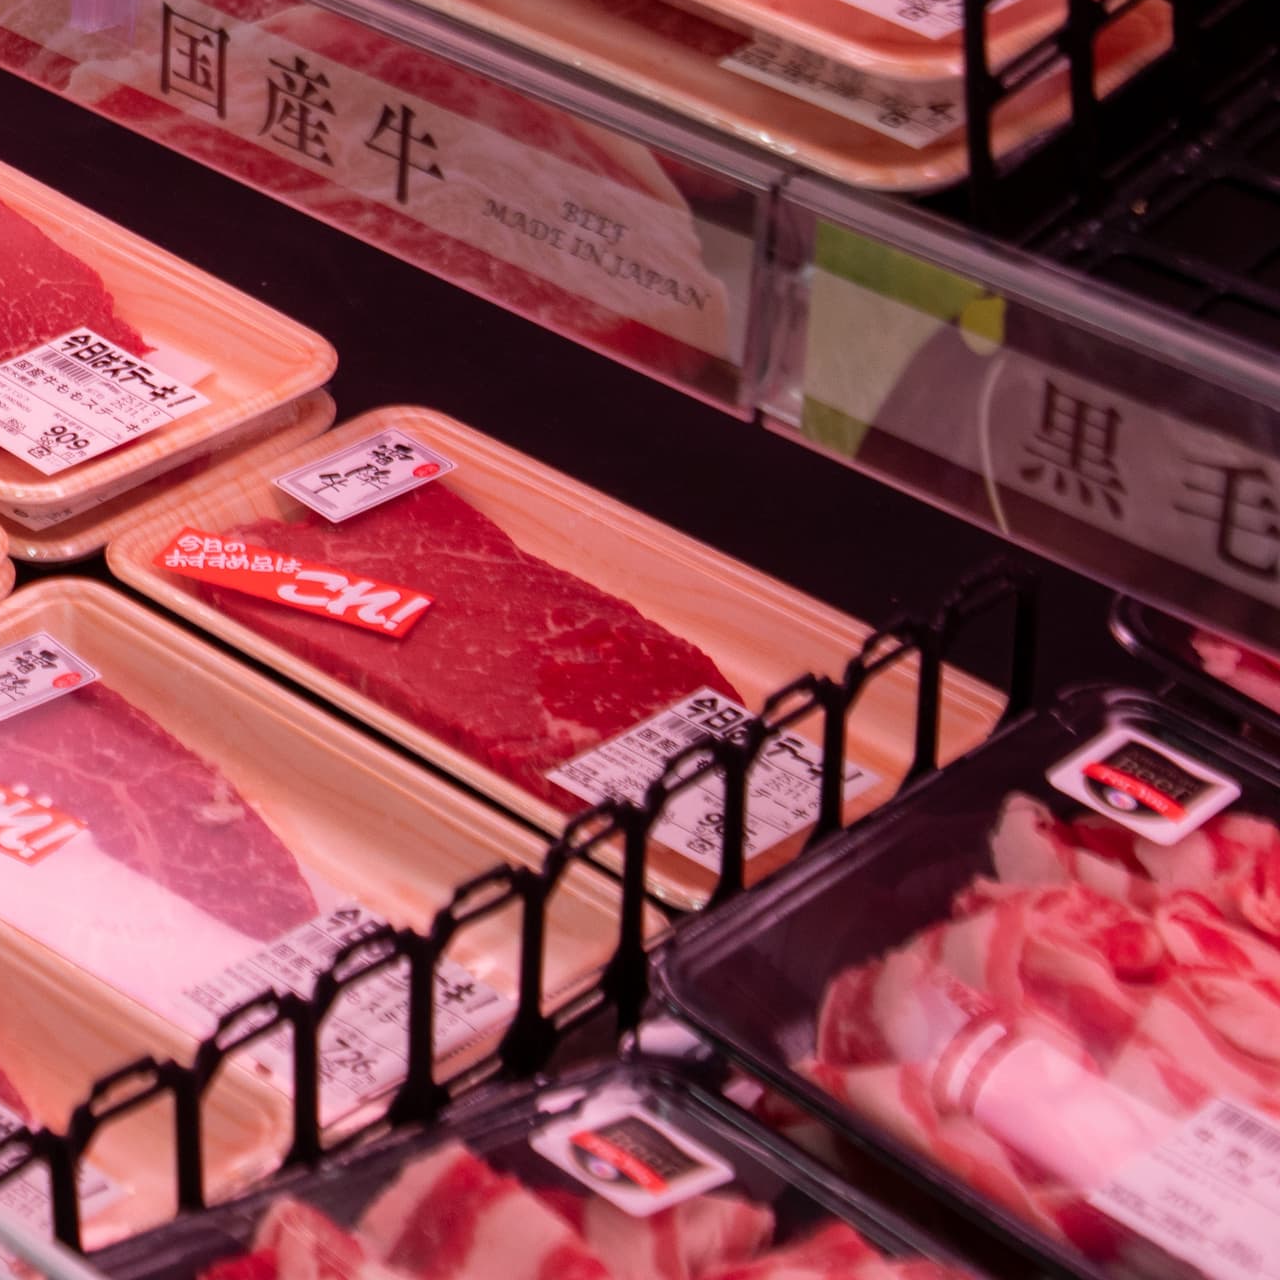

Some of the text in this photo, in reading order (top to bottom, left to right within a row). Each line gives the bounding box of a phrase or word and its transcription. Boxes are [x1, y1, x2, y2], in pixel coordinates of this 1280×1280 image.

[160, 2, 445, 204] 国産牛
[483, 198, 713, 311] MADE IN JAPAN
[562, 200, 627, 244] BEEF
[13, 359, 140, 434] 国産牛ももステーキ
[60, 334, 197, 409] 今日はステーキ!
[43, 425, 90, 451] 909
[1023, 379, 1280, 579] 黒毛
[164, 551, 302, 575] おすすめ品は
[177, 535, 246, 553] 今日の
